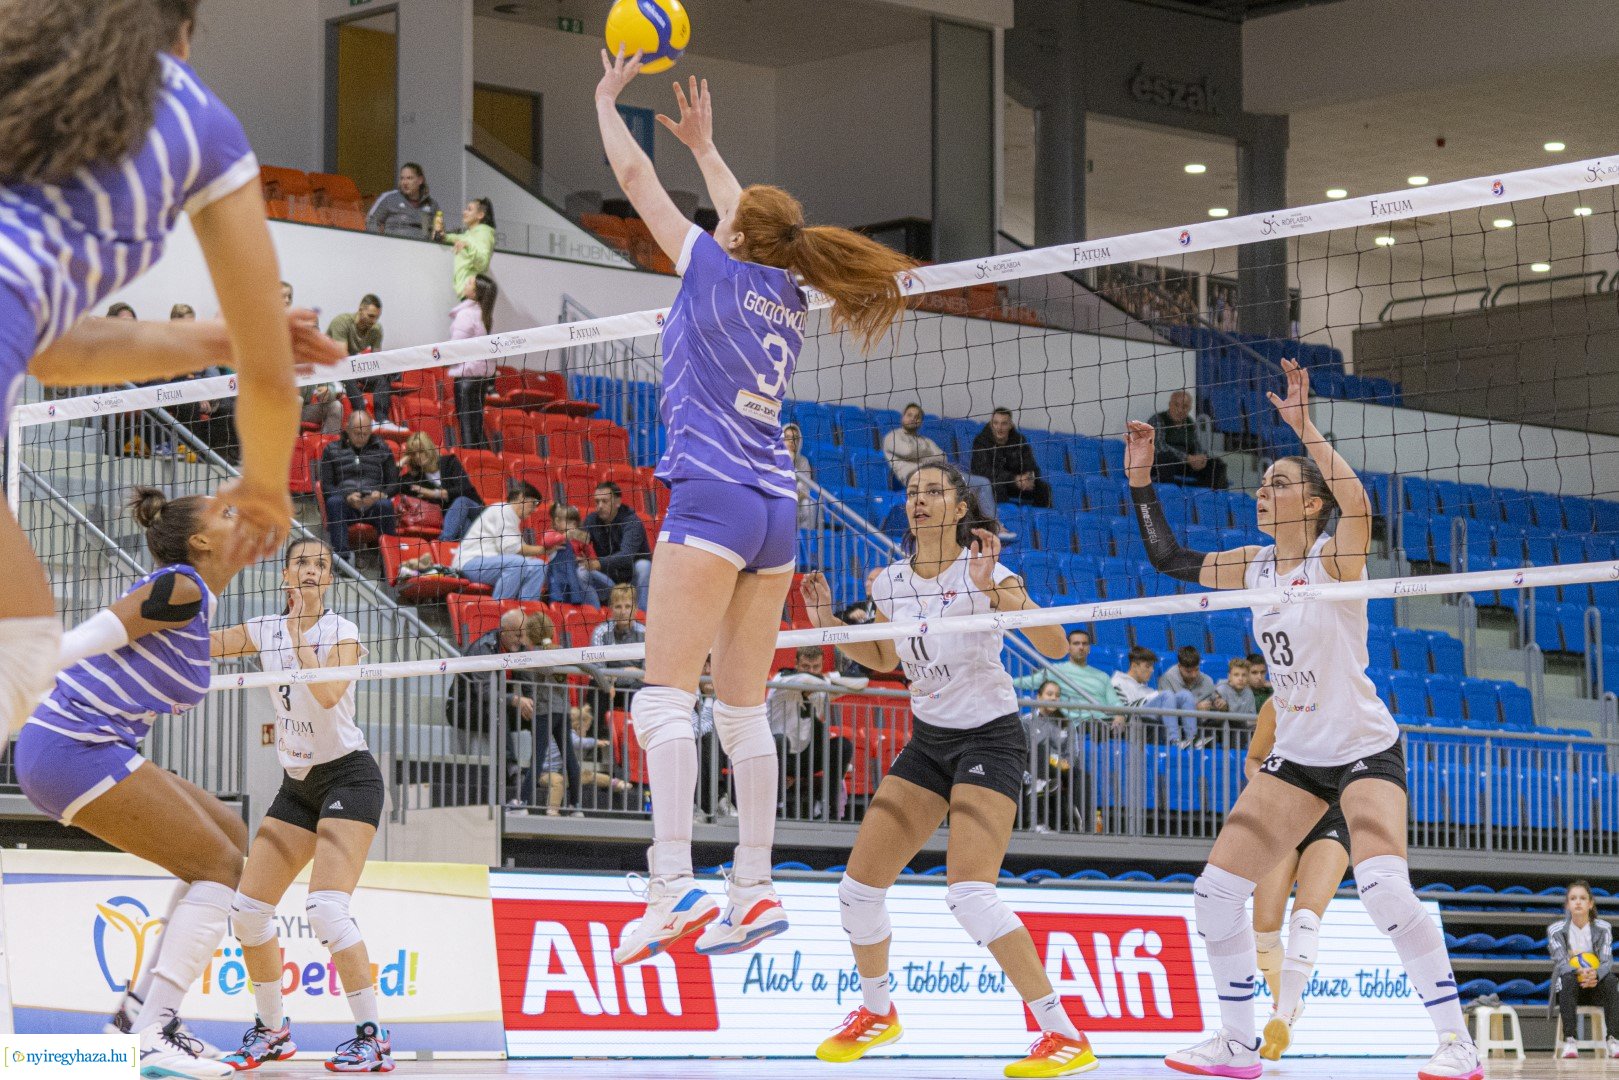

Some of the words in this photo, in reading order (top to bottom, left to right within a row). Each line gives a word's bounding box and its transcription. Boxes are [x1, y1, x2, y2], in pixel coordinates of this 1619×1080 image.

[1371, 200, 1413, 215] FATUM
[1073, 247, 1111, 261] FATUM
[569, 326, 600, 340] FATUM
[351, 359, 380, 373] FATUM
[757, 333, 788, 396] 3
[156, 388, 183, 402] FATUM
[1393, 581, 1427, 594] FATUM
[822, 631, 849, 642] FATUM
[908, 636, 930, 661] 11
[1262, 631, 1293, 667] 23
[278, 684, 291, 712] 3
[1045, 927, 1174, 1019] Alfi
[811, 972, 828, 992] a
